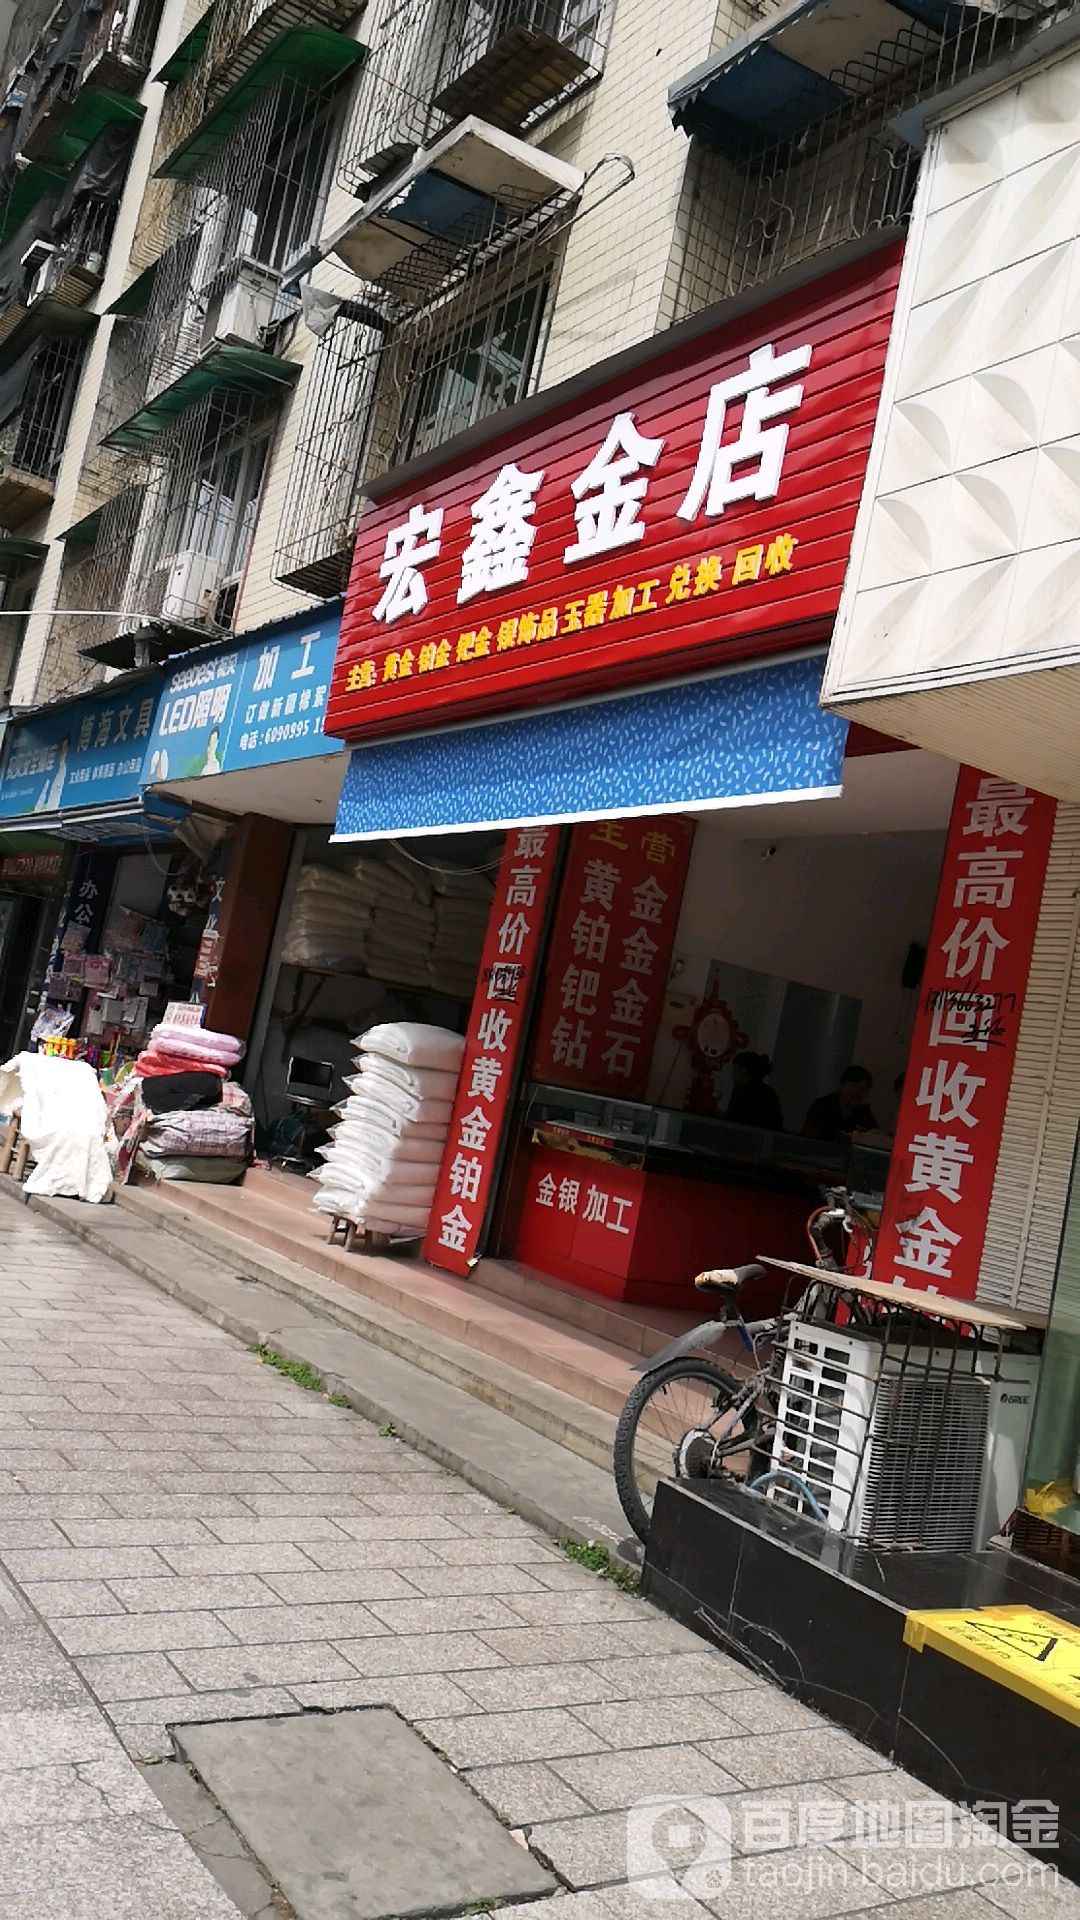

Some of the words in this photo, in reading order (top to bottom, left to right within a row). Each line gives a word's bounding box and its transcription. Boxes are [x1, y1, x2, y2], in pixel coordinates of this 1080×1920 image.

[372, 343, 812, 624] 宏鑫金店
[253, 631, 321, 692] 加工
[159, 684, 232, 736] LED照明
[893, 778, 1034, 1295] 最高价回收黄金
[536, 1172, 633, 1234] 金银加工
